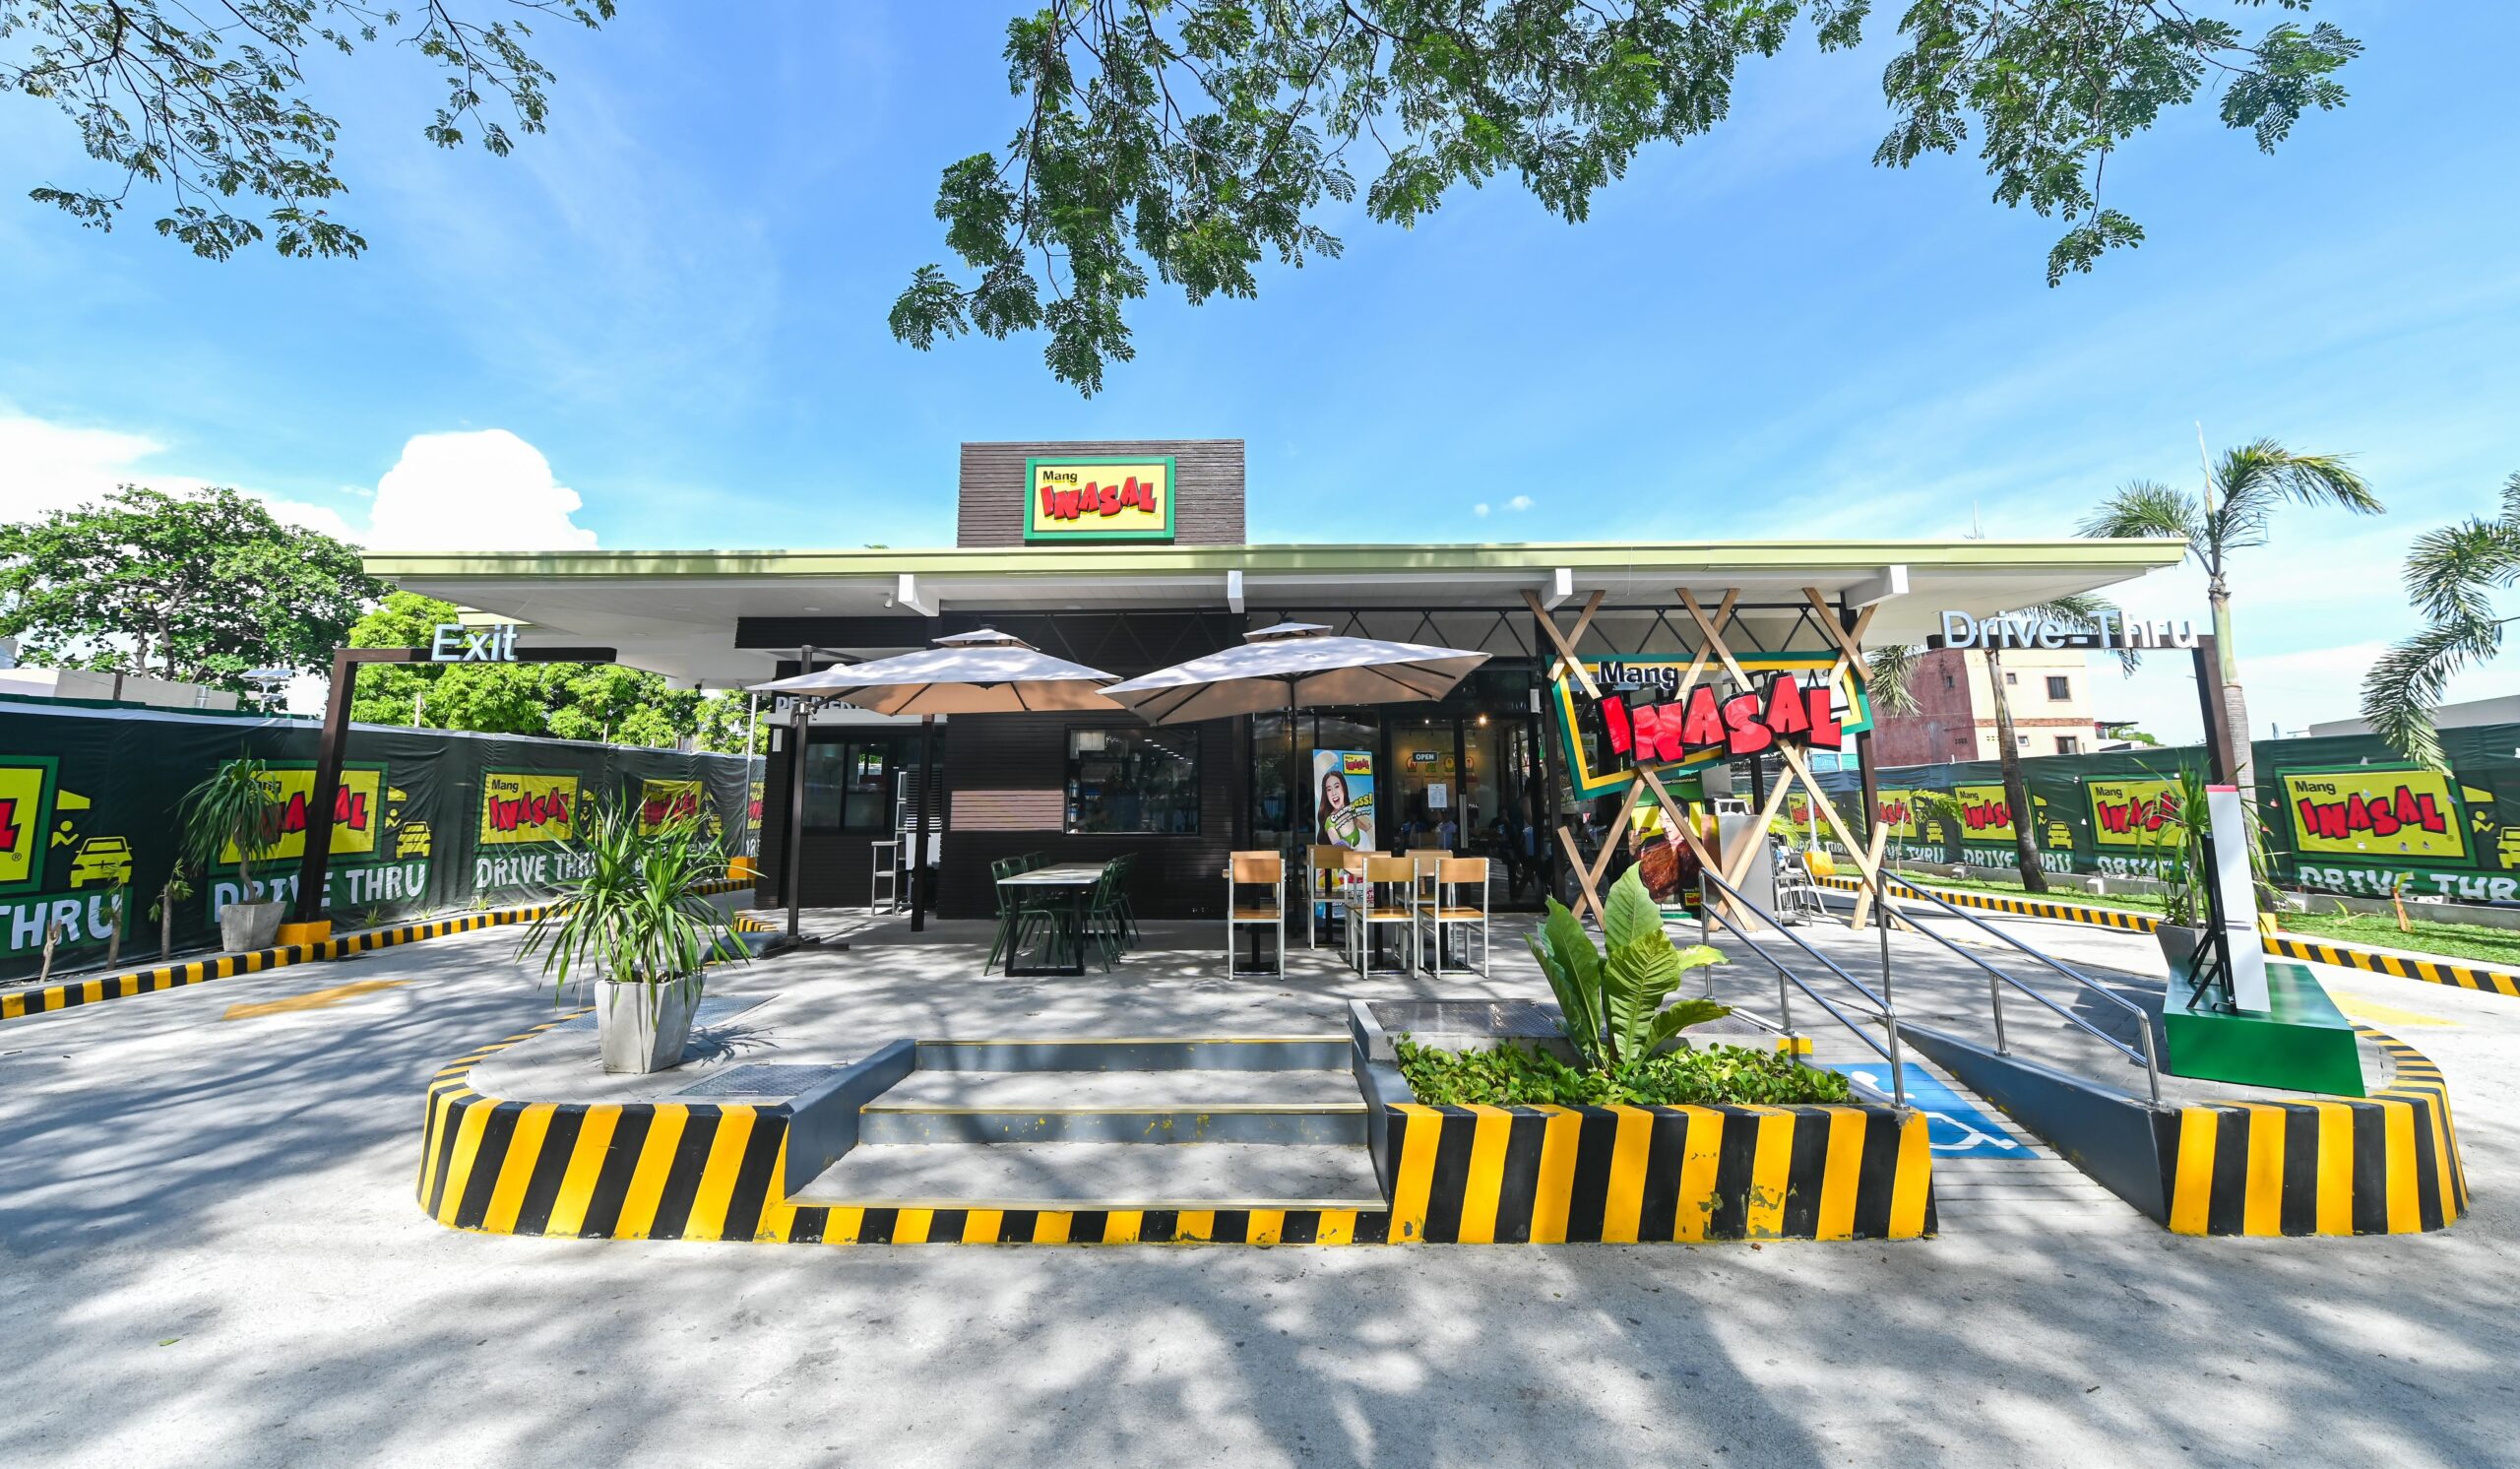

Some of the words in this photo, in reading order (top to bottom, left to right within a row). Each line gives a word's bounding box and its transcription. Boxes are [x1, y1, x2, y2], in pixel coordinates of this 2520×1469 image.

[1042, 470, 1078, 483] Mang
[1040, 476, 1158, 521] INASAL
[431, 623, 518, 661] Exit
[1939, 609, 2199, 649] Drive-Thru
[1599, 661, 1678, 690] Mang
[1595, 671, 1842, 764] INASAL
[492, 779, 519, 793] Mang
[1959, 791, 1980, 800] Mang
[2096, 787, 2123, 798] Mang
[2295, 780, 2336, 795] Mang
[488, 787, 569, 832] INASAL
[1962, 798, 2012, 830] INAS
[2297, 785, 2447, 840] INASAL
[475, 855, 547, 888] DRIVE
[553, 850, 597, 881] THR
[1963, 849, 2015, 867] DRIVE
[2040, 853, 2072, 874] RU
[346, 863, 426, 904] THRU
[2299, 866, 2415, 900] DRIVE
[0, 894, 122, 949] HRU
